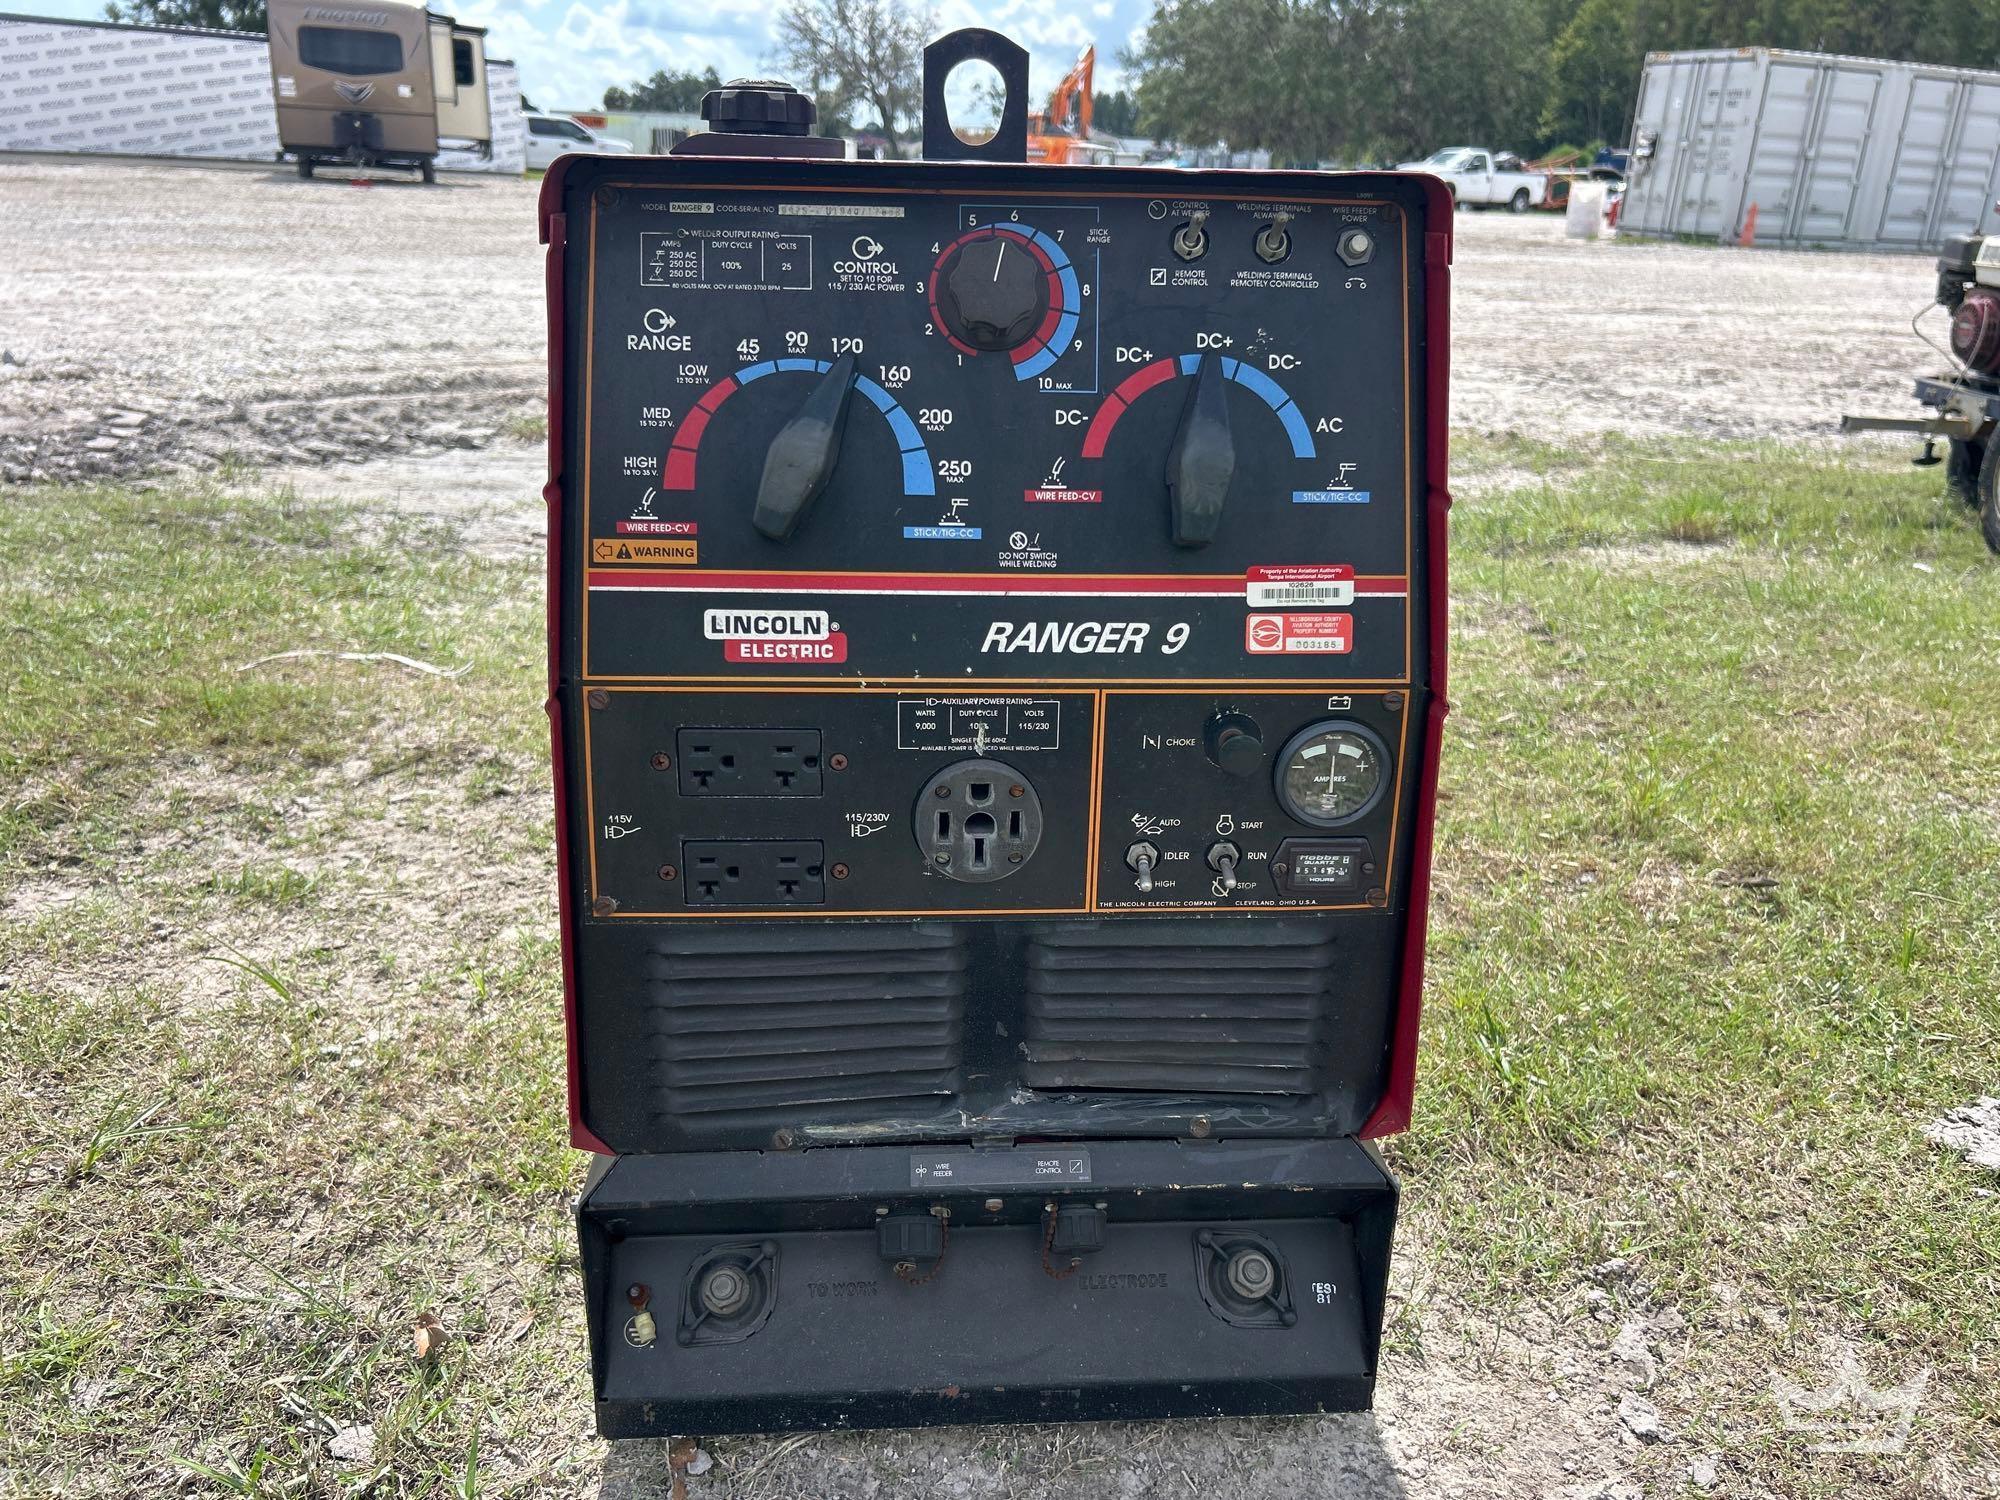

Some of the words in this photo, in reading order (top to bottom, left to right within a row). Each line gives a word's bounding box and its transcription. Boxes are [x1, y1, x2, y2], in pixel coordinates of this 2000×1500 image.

[641, 203, 668, 211] MODEL
[671, 204, 701, 212] RANGER
[705, 204, 712, 213] 9
[716, 204, 761, 213] CODE-SERIAL
[1172, 201, 1210, 210] CONTROL
[1236, 202, 1270, 211] WELDING
[1272, 203, 1312, 213] TERMINALS
[1332, 206, 1350, 214] WIRE
[1351, 207, 1377, 215] FEEDER
[1010, 210, 1019, 222] 6
[1170, 209, 1180, 217] AT
[1341, 214, 1368, 222] POWER
[968, 214, 977, 226] 5
[690, 230, 721, 238] WELDER
[722, 230, 750, 239] OUTPUT
[751, 231, 780, 239] RATING
[1056, 230, 1065, 242] 7
[660, 240, 682, 248] AMPS
[711, 241, 729, 249] DUTY
[730, 241, 753, 249] CYCLE
[1086, 236, 1111, 244] RANGE
[931, 241, 940, 254] 4
[669, 251, 684, 259] 250
[685, 251, 697, 259] AC
[669, 260, 684, 268] 250
[721, 261, 742, 270] 100%
[781, 263, 792, 271] 25
[833, 261, 899, 275] CONTROL
[669, 270, 684, 278] 250
[685, 270, 698, 278] DC
[1175, 269, 1206, 278] REMOTE
[1236, 271, 1271, 279] WELDING
[1273, 272, 1313, 280] TERMINALS
[852, 275, 864, 283] TO
[866, 275, 876, 283] 10
[1171, 278, 1209, 286] CONTROL
[1230, 279, 1268, 287] REMOTELY
[1269, 280, 1319, 289] CONTROLLED
[828, 282, 842, 291] 115
[848, 283, 863, 291] 230
[863, 283, 876, 291] AC
[877, 284, 905, 292] POWER
[916, 281, 924, 294] 3
[1082, 284, 1091, 296] 8
[924, 323, 933, 336] 2
[627, 334, 692, 351] RANGE
[785, 331, 809, 347] 90
[1196, 332, 1234, 348] DC+
[736, 338, 760, 355] 45
[831, 337, 864, 354] 120
[1074, 339, 1082, 351] 9
[957, 354, 962, 366] 1
[1116, 347, 1153, 363] DC+
[1268, 354, 1302, 370] DC-
[679, 364, 708, 376] LOW
[879, 365, 911, 382] 160
[885, 381, 903, 389] MAX
[1038, 377, 1052, 389] 10
[1055, 382, 1073, 390] MAX
[643, 407, 671, 419] MED
[918, 408, 953, 425] 200
[1055, 409, 1089, 426] DC-
[927, 424, 945, 432] MAX
[1315, 417, 1344, 433] AC
[624, 456, 657, 468] HIGH
[938, 460, 972, 477] 250
[946, 476, 964, 484] MAX
[1035, 491, 1056, 500] WIRE
[1058, 491, 1096, 501] FEED-CV
[1302, 492, 1363, 501] STICK/TIG-CC
[626, 523, 649, 532] WIRE
[650, 523, 690, 532] FEED-CV
[913, 527, 974, 538] STICK/TIG-CC
[633, 546, 695, 558] WARNING
[998, 552, 1011, 560] DO
[1012, 552, 1029, 560] NOT
[1029, 552, 1058, 560] SWITCH
[998, 560, 1021, 568] WHILE
[1022, 560, 1057, 568] WELDING
[711, 615, 821, 635] LINCOLN
[980, 621, 1150, 654] RANGER
[1161, 622, 1191, 655] 9
[740, 643, 834, 658] ELECTRIC
[942, 697, 978, 705] AUXILIARY
[979, 697, 1005, 705] POWER
[1006, 697, 1033, 705] RATING
[915, 723, 936, 731] 9,000
[1018, 722, 1050, 730] 115/230
[1165, 737, 1196, 747] CHOKE
[608, 814, 633, 823] 115V
[844, 813, 890, 822] 115/230V
[1240, 821, 1264, 829] START
[1164, 851, 1190, 860] IDLER
[1247, 851, 1267, 860] RUN
[1154, 880, 1176, 888] HIGH
[1236, 882, 1257, 890] STOP
[1079, 1273, 1169, 1290] ELECTRODE
[807, 1282, 829, 1298] TO
[832, 1281, 878, 1297] WORK
[1316, 1293, 1331, 1304] 81
